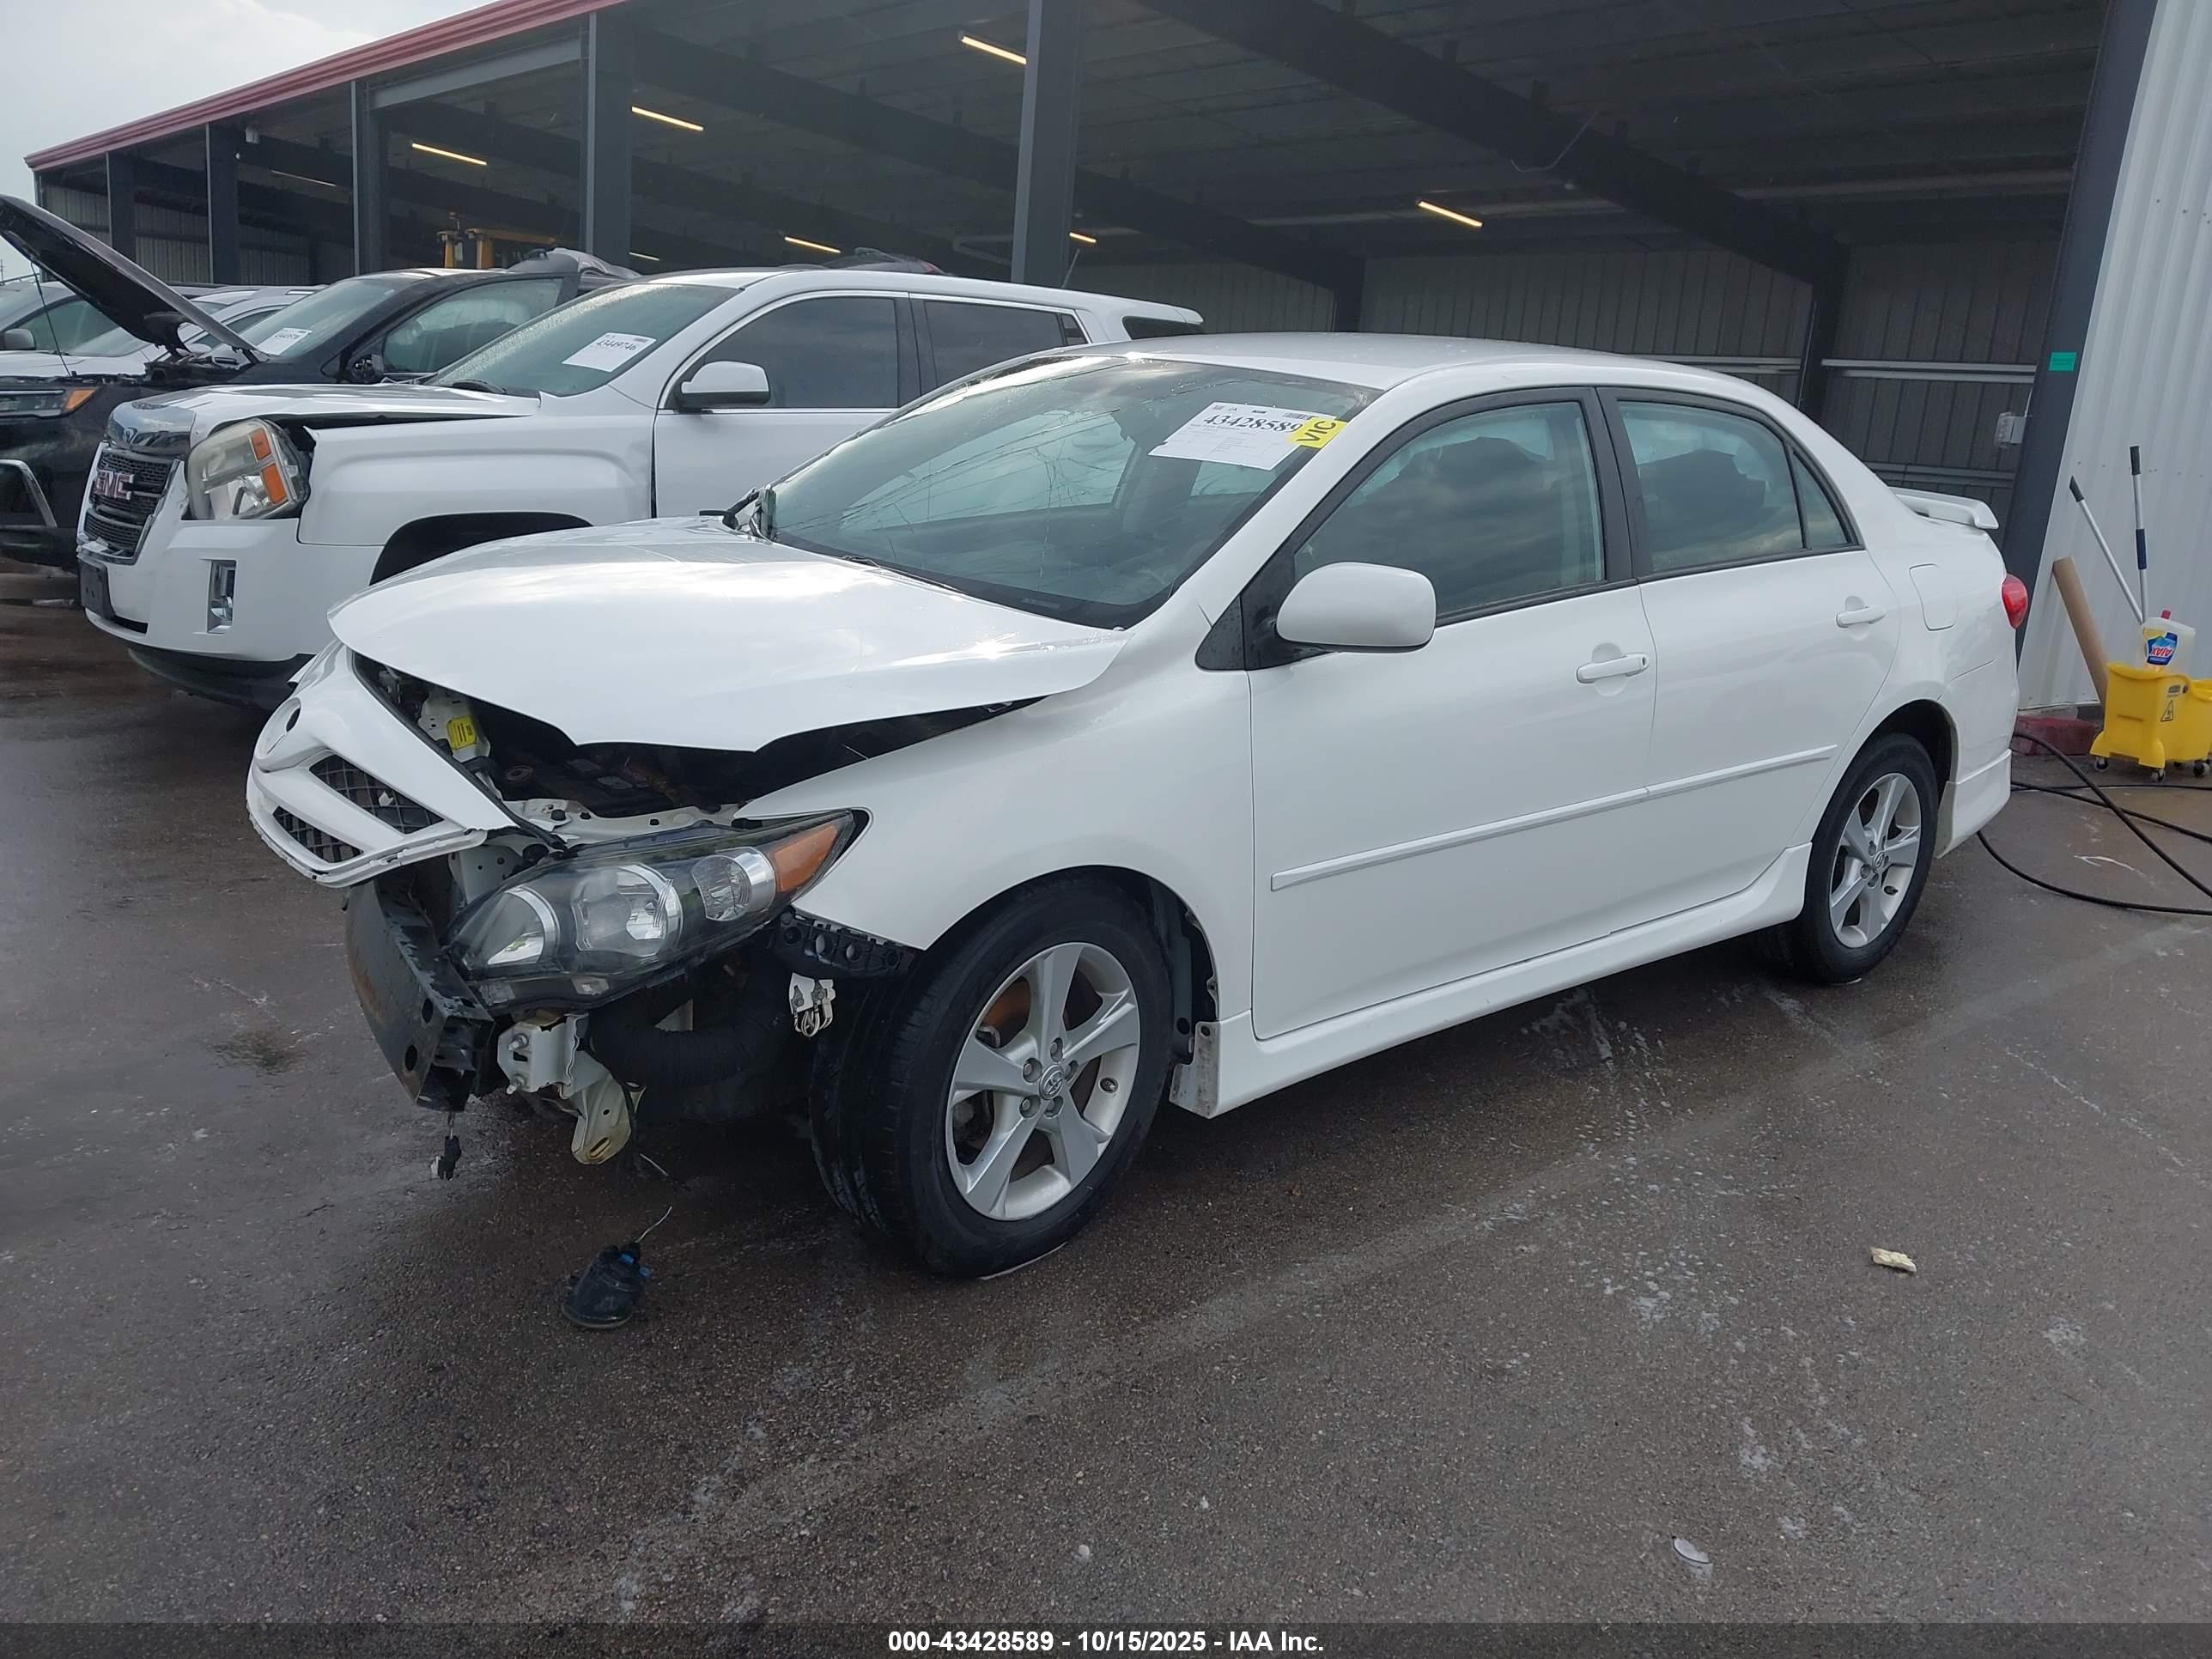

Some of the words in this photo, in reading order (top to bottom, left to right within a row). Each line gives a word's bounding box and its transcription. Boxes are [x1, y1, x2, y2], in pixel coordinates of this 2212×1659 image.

[1204, 414, 1303, 433] 43428589
[1296, 420, 1336, 443] VIC
[94, 469, 134, 500] GMC
